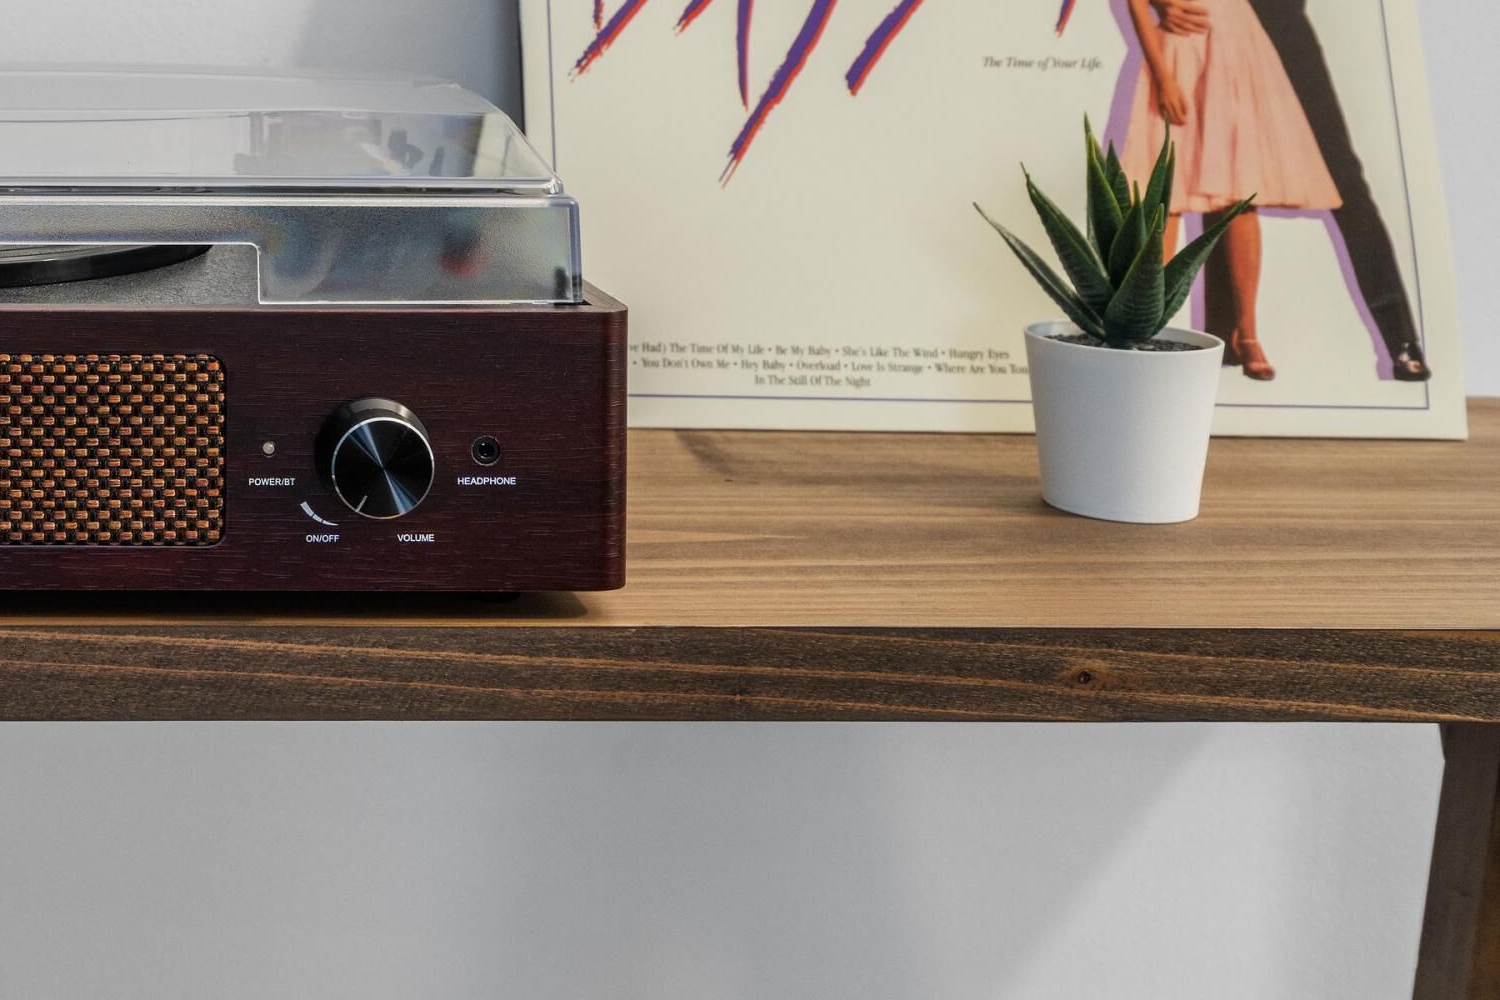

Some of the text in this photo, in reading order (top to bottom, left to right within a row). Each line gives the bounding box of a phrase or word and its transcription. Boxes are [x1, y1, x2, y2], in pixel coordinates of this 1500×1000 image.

[983, 56, 1003, 68] The
[1006, 56, 1034, 68] Time
[669, 342, 687, 353] The
[689, 343, 714, 354] Time
[716, 342, 729, 354] Of
[731, 344, 744, 356] My
[747, 344, 765, 355] Life
[775, 345, 787, 355] Be
[790, 345, 804, 357] My
[807, 345, 831, 358] Baby
[841, 346, 867, 357] She's
[869, 346, 890, 357] Like
[891, 347, 911, 358] The
[913, 348, 938, 358] Wind
[948, 348, 985, 361] Hungry
[988, 349, 1010, 361] Eyes
[641, 357, 660, 368] You
[662, 358, 689, 368] Don't
[691, 358, 714, 369] Own
[716, 359, 731, 369] Me
[741, 360, 759, 372] Hey
[762, 360, 786, 372] Baby
[796, 360, 841, 371] Overload
[851, 362, 874, 372] Love
[876, 362, 886, 372] Is
[887, 363, 924, 375] Strange
[934, 363, 966, 375] Where
[968, 364, 986, 375] Are
[988, 363, 1008, 375] You
[754, 375, 871, 390] In The Still Of The Night
[248, 477, 296, 487] POWER/BT
[457, 476, 517, 486] HEADPHONE
[305, 534, 340, 543] ON/OFF
[397, 533, 435, 543] VOLUME
